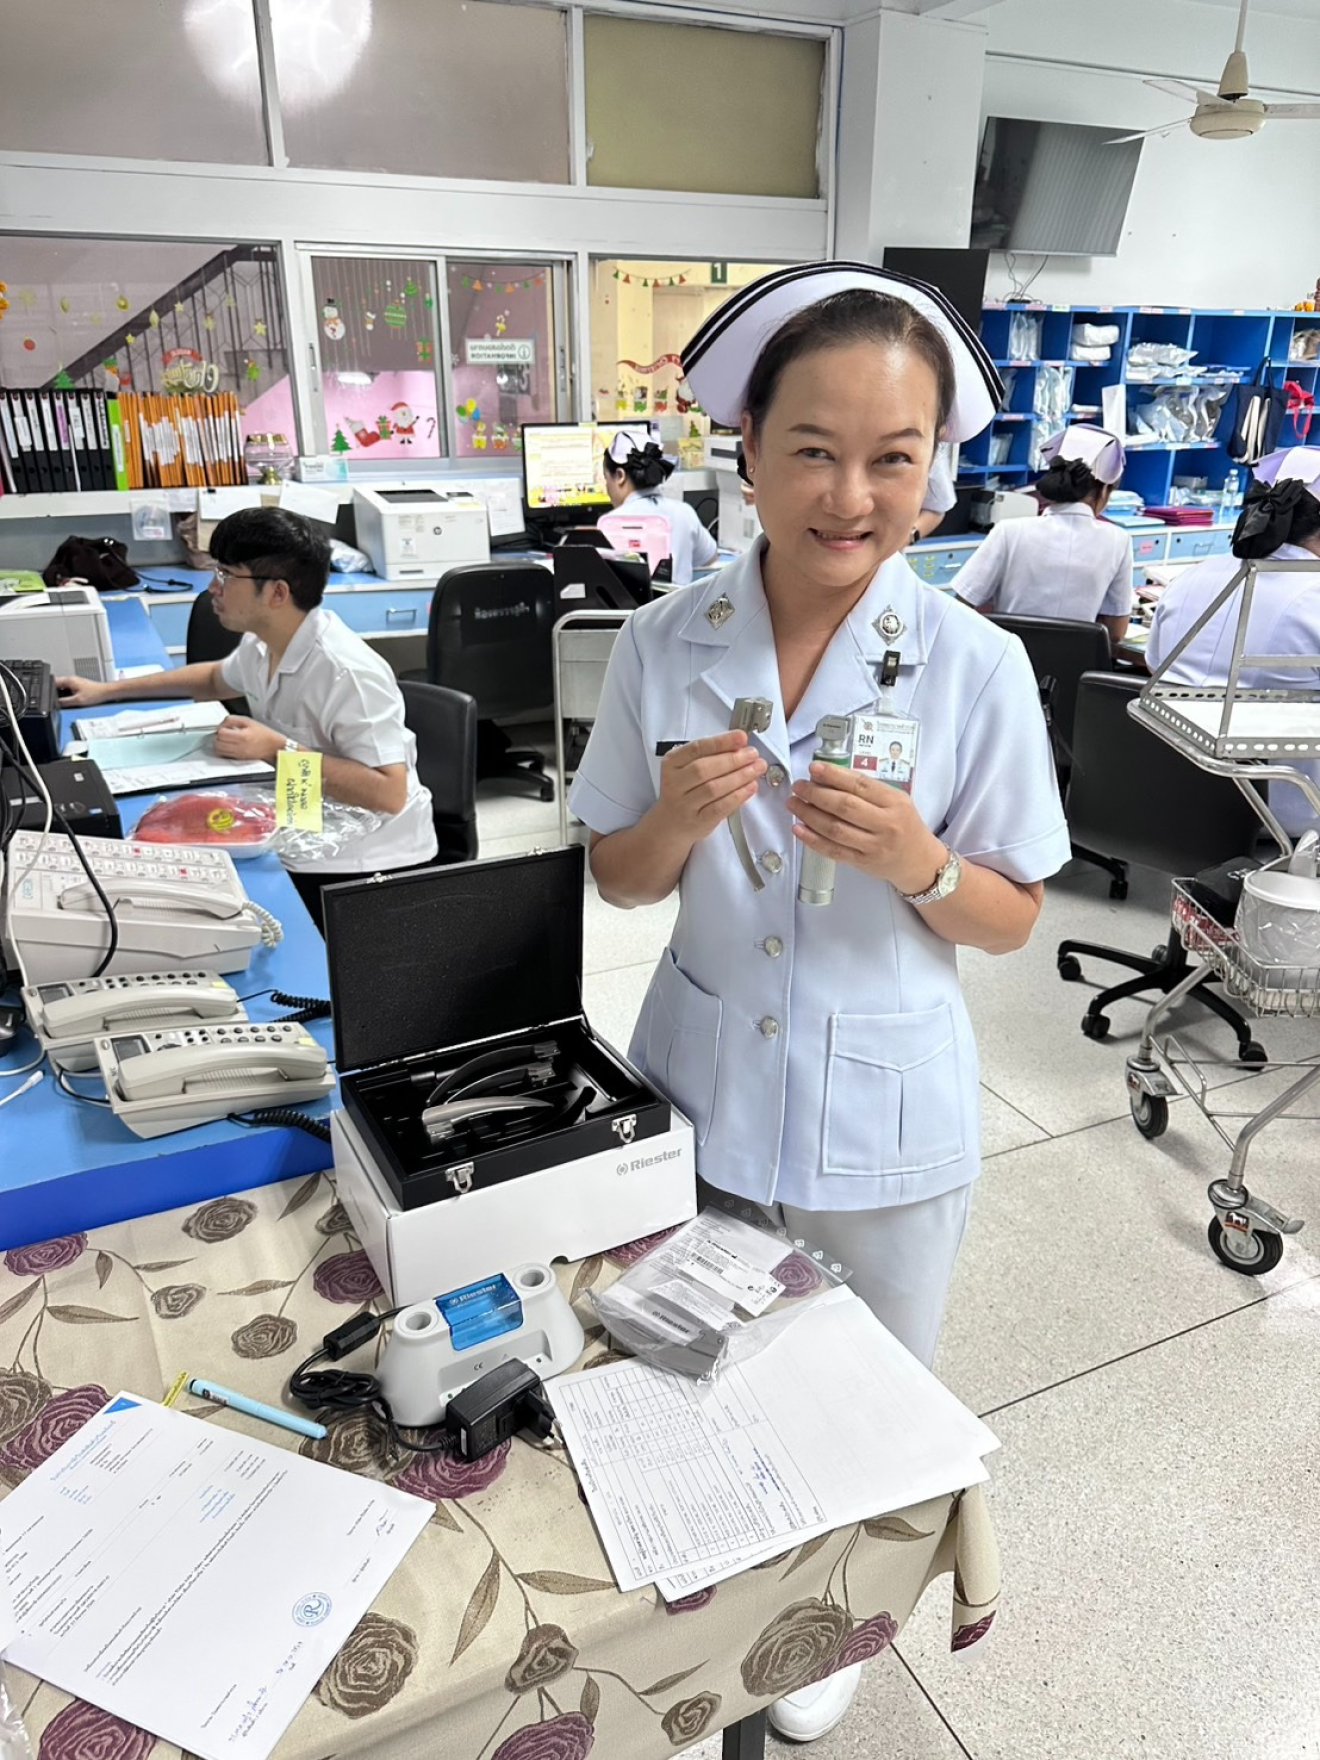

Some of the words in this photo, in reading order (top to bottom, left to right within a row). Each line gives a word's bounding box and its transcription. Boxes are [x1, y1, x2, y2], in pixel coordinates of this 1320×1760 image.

[713, 262, 722, 280] 1
[858, 734, 874, 745] RN
[860, 757, 868, 768] 4
[630, 1148, 683, 1171] Riester
[459, 1284, 497, 1302] Riester
